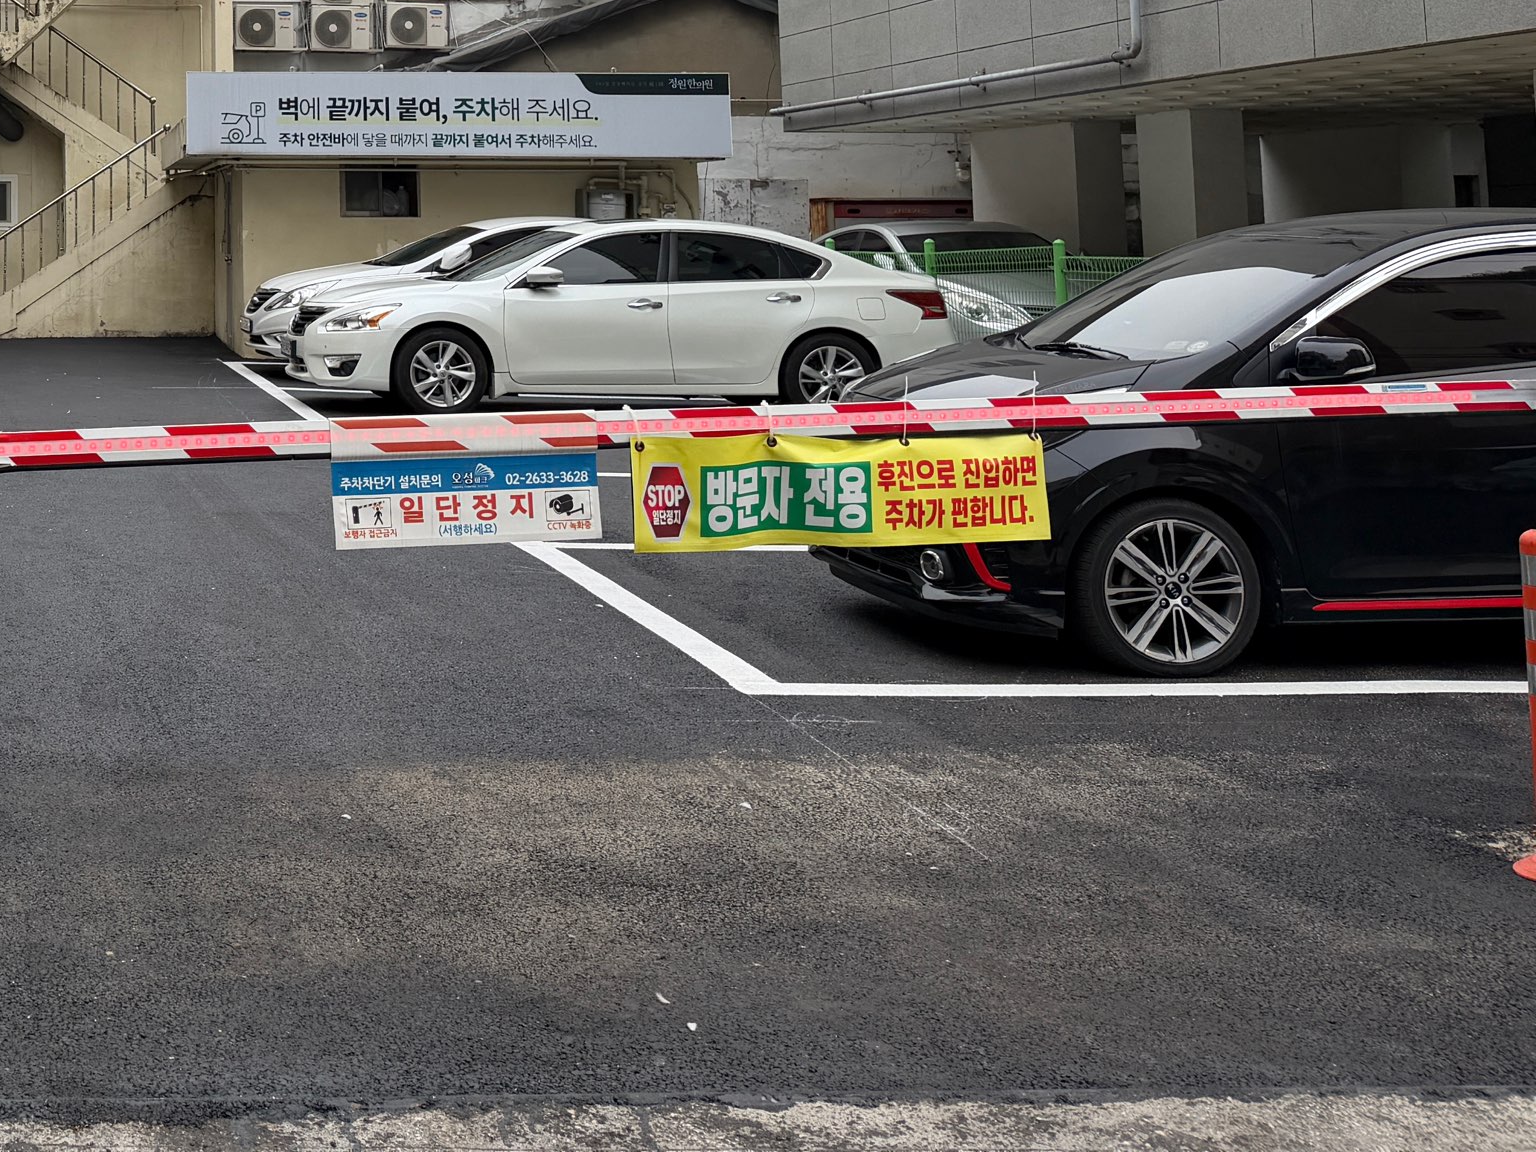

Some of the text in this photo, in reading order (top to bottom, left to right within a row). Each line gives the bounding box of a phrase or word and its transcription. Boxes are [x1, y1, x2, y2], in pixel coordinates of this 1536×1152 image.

[669, 78, 713, 90] 정원한의원
[279, 97, 598, 124] 벽에 끝까지 붙여, 주차해 주세요.
[279, 133, 597, 148] 주차 안전바에 닿을 때까지 끝까지 붙여서 주차해주세요.
[341, 476, 395, 491] 주차차단기
[399, 474, 441, 489] 설치문의
[505, 471, 588, 485] 02-2633-3628
[877, 455, 1037, 492] 후진으로 진입하면
[648, 485, 684, 507] STOP
[706, 466, 867, 531] 방문자 전용
[652, 510, 680, 525] 일단정지
[884, 494, 1034, 530] 주차가 편합니다.
[344, 529, 397, 539] 보행자 접근금지
[438, 522, 497, 537] (서행하세요)
[547, 521, 592, 530] CCTV 녹화중
